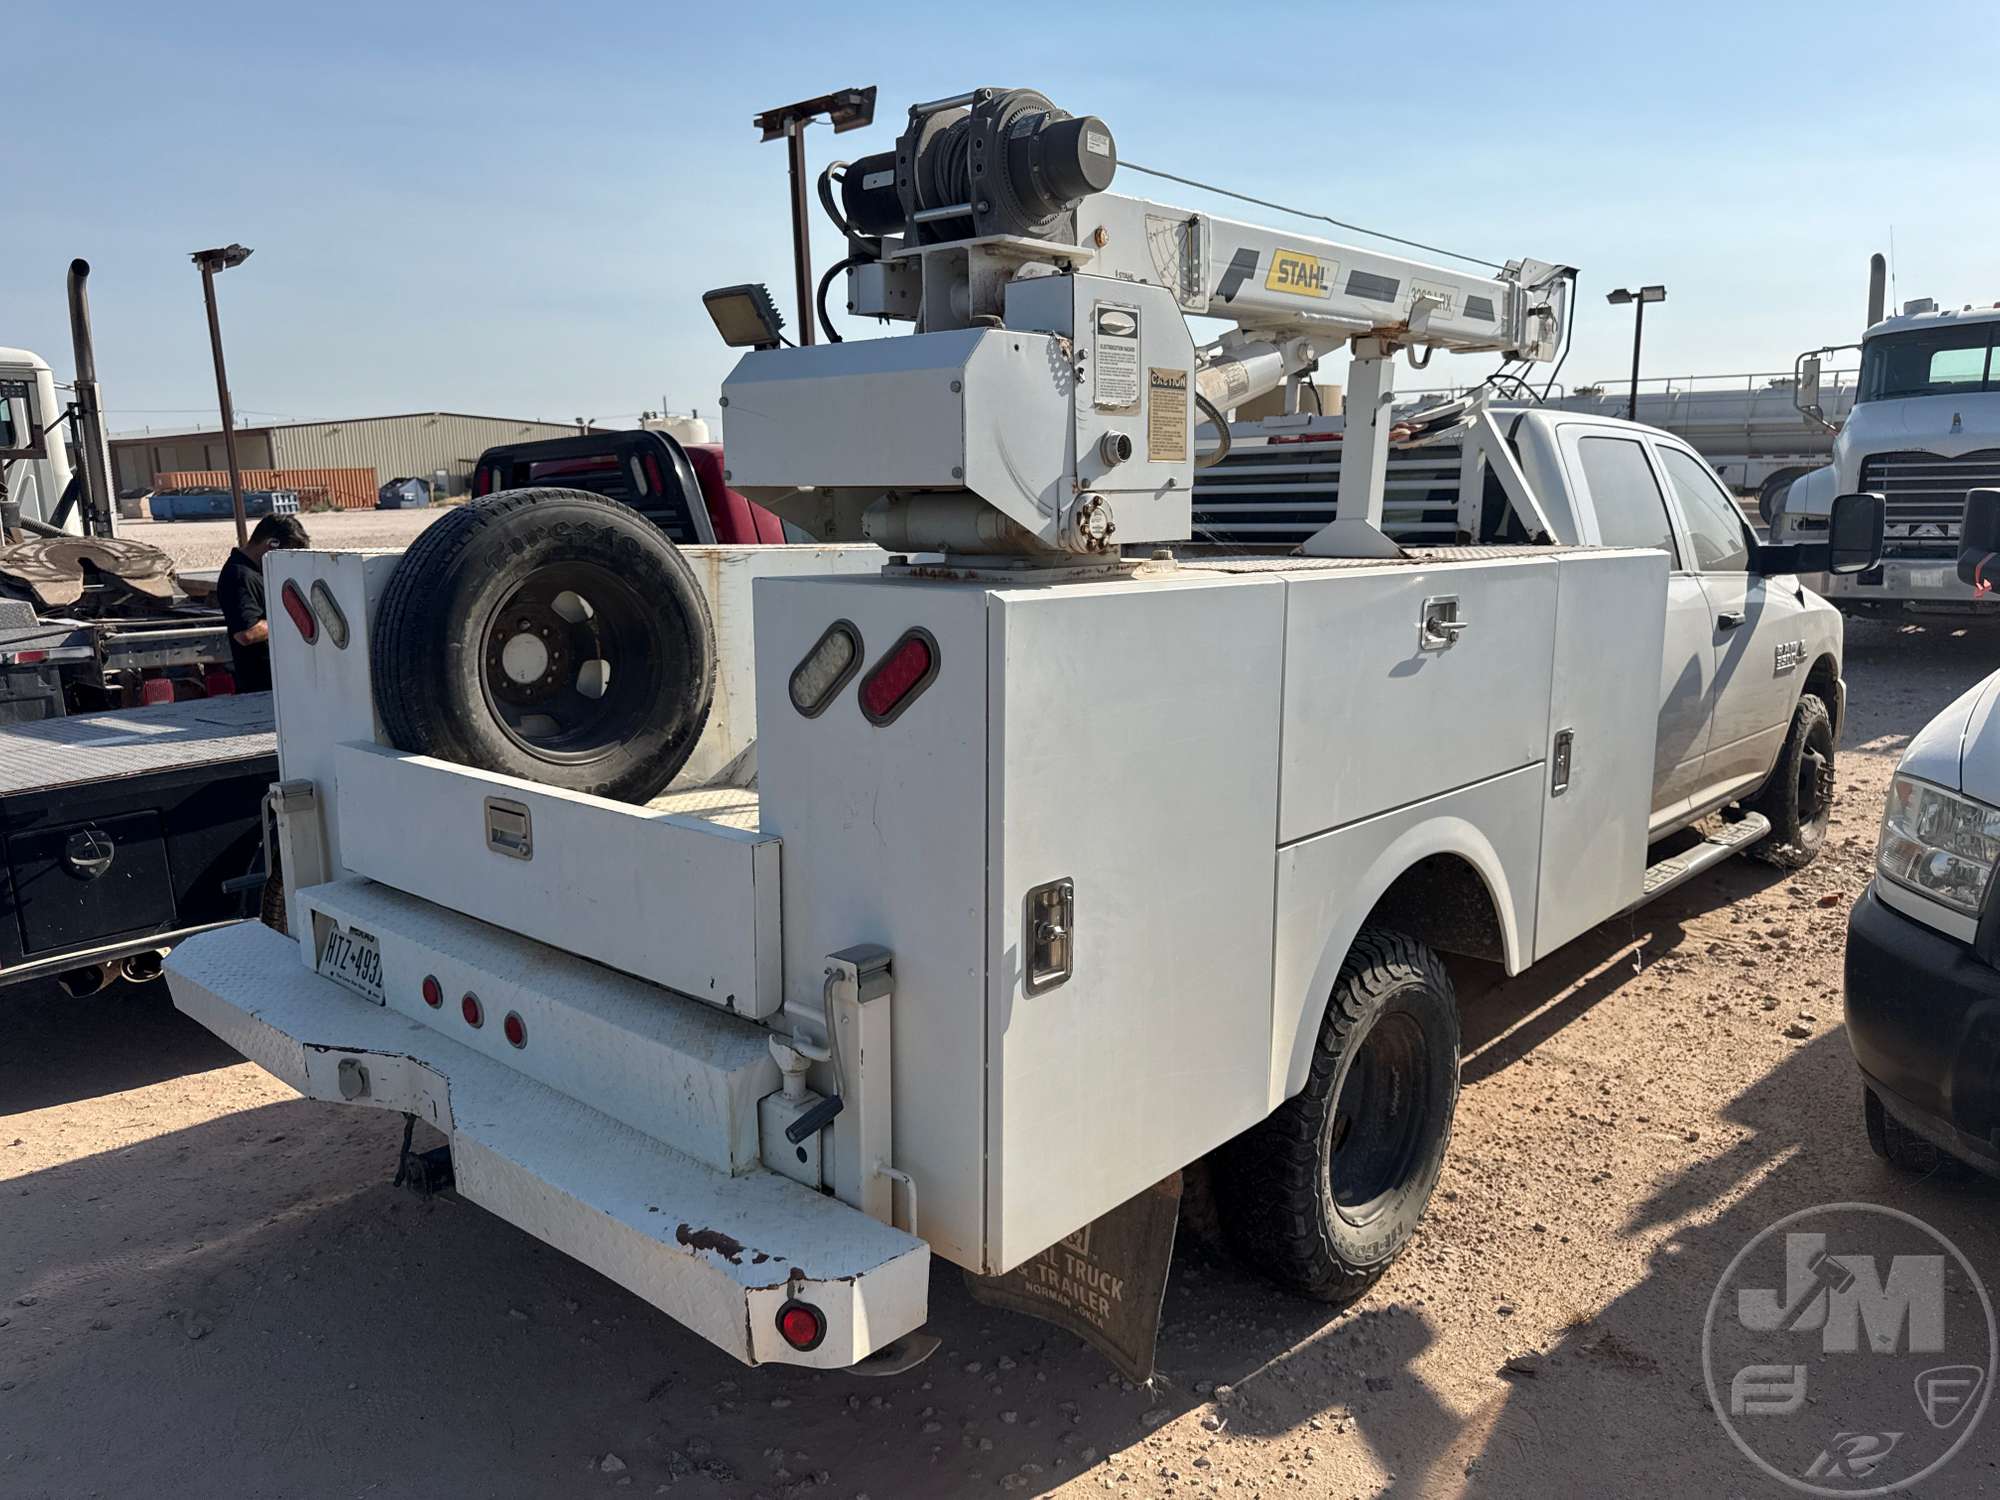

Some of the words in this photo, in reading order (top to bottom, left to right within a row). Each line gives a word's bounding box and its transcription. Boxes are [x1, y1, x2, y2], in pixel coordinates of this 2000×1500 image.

[1278, 259, 1328, 291] STAHL
[325, 931, 352, 970] HTZ
[1037, 1263, 1110, 1319] TRAILER
[1065, 1254, 1124, 1302] TRUCK
